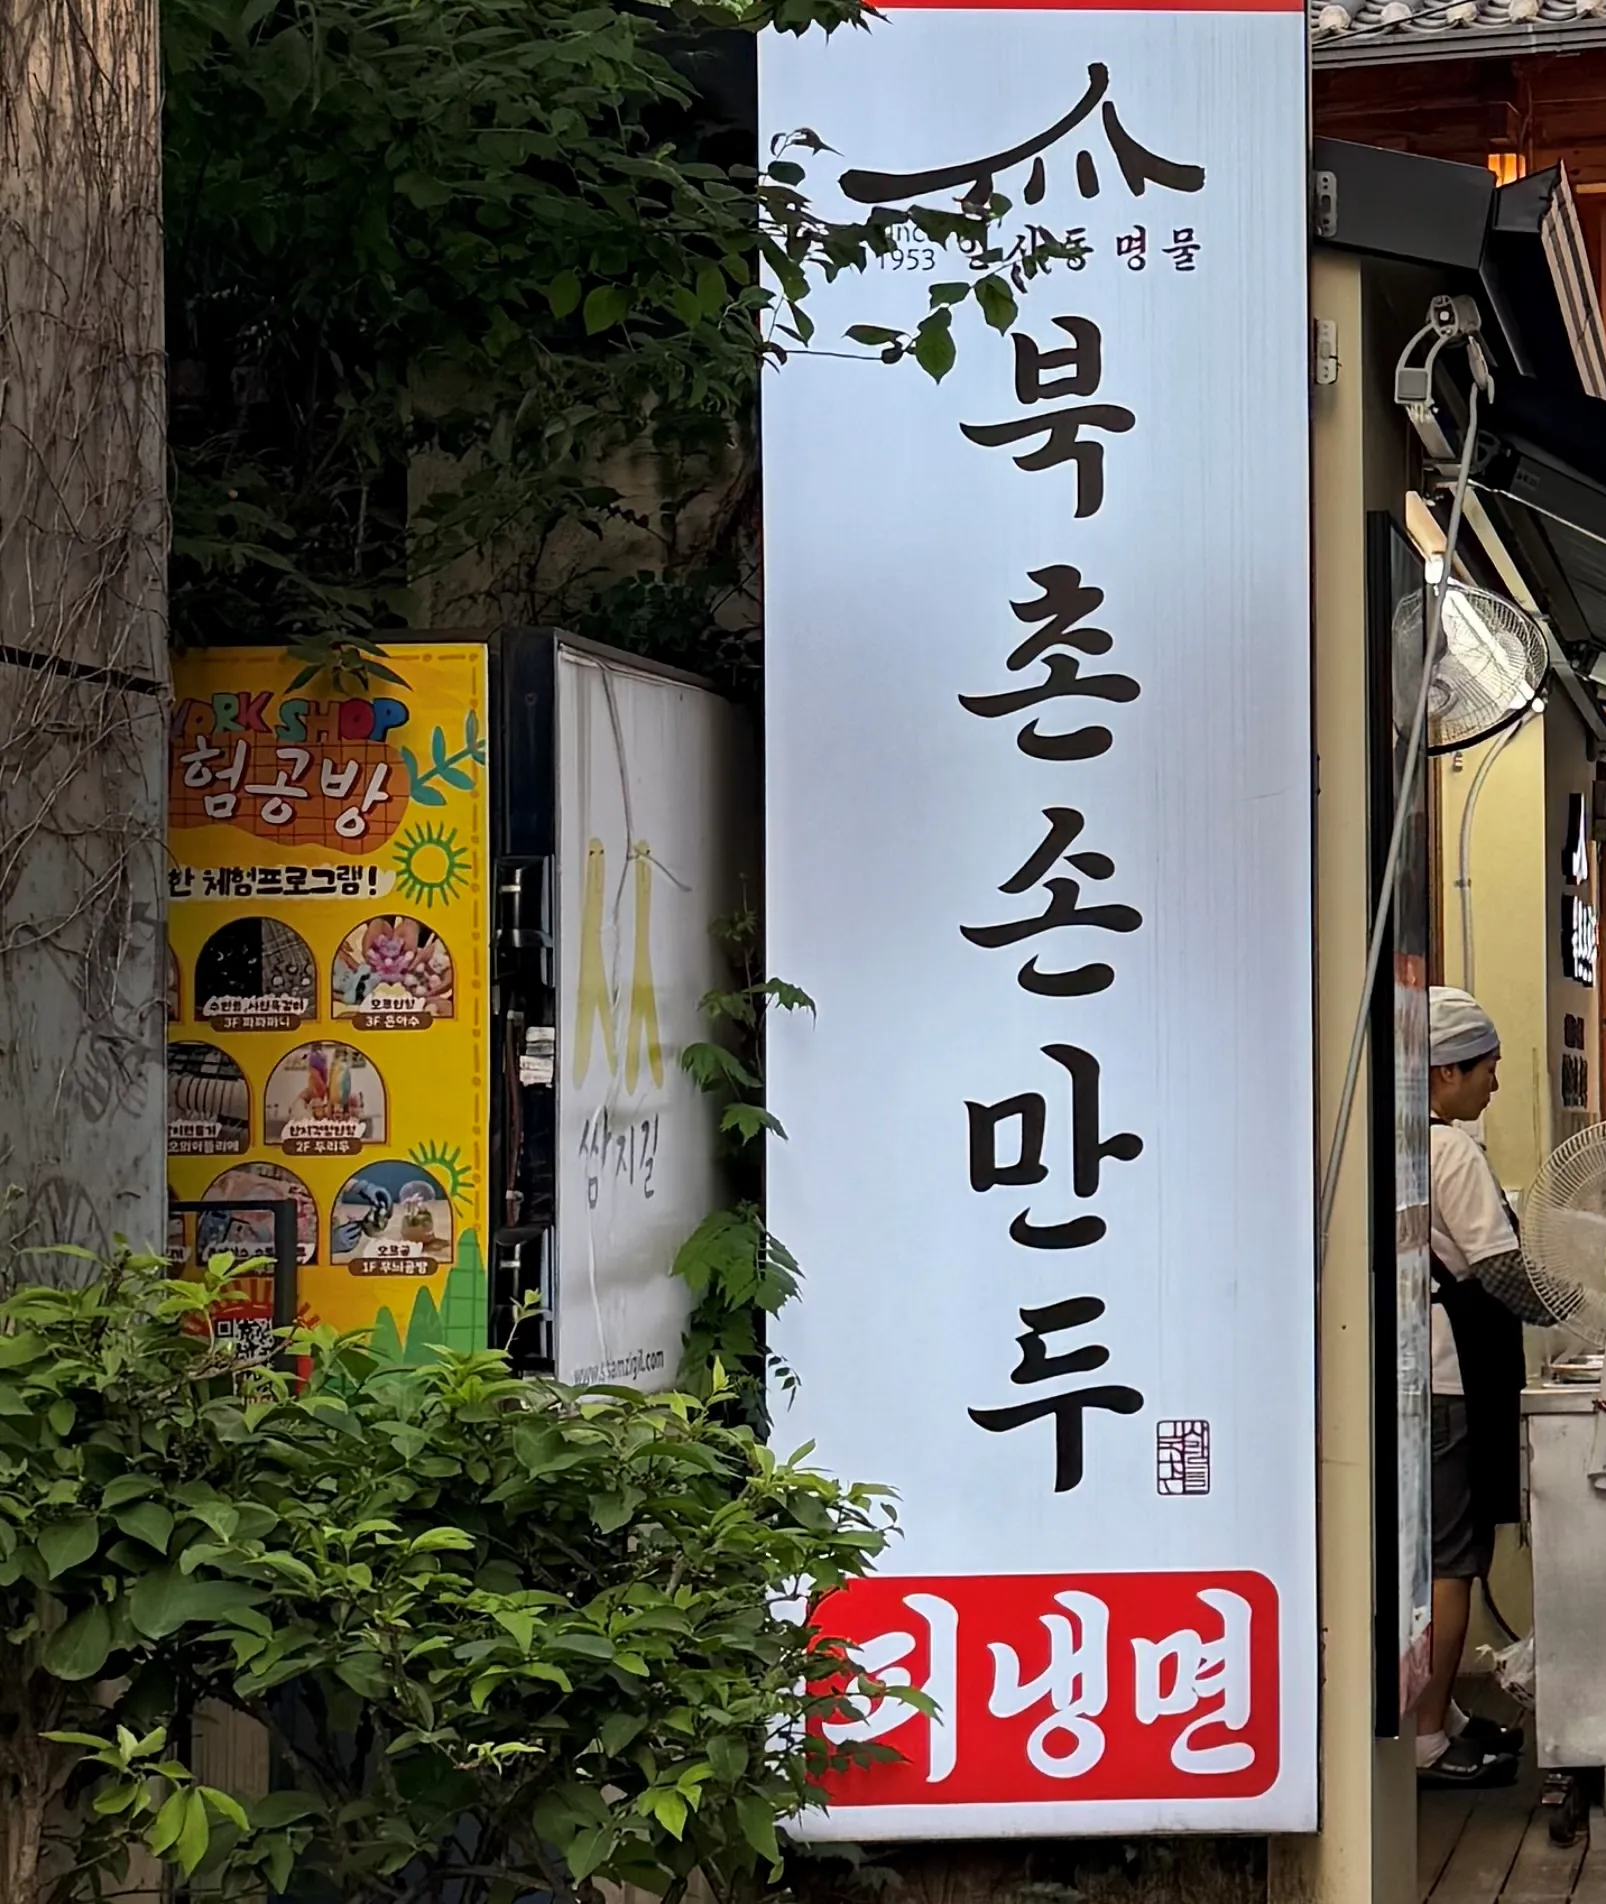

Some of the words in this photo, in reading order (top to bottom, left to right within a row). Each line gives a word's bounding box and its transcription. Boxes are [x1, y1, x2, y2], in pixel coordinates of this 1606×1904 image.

[276, 698, 409, 742] SHOP
[180, 736, 389, 837] 험공방
[202, 865, 377, 896] 체험프로그램!
[959, 316, 1145, 1493] 북촌손만두
[579, 1106, 659, 1209] 쌈지길
